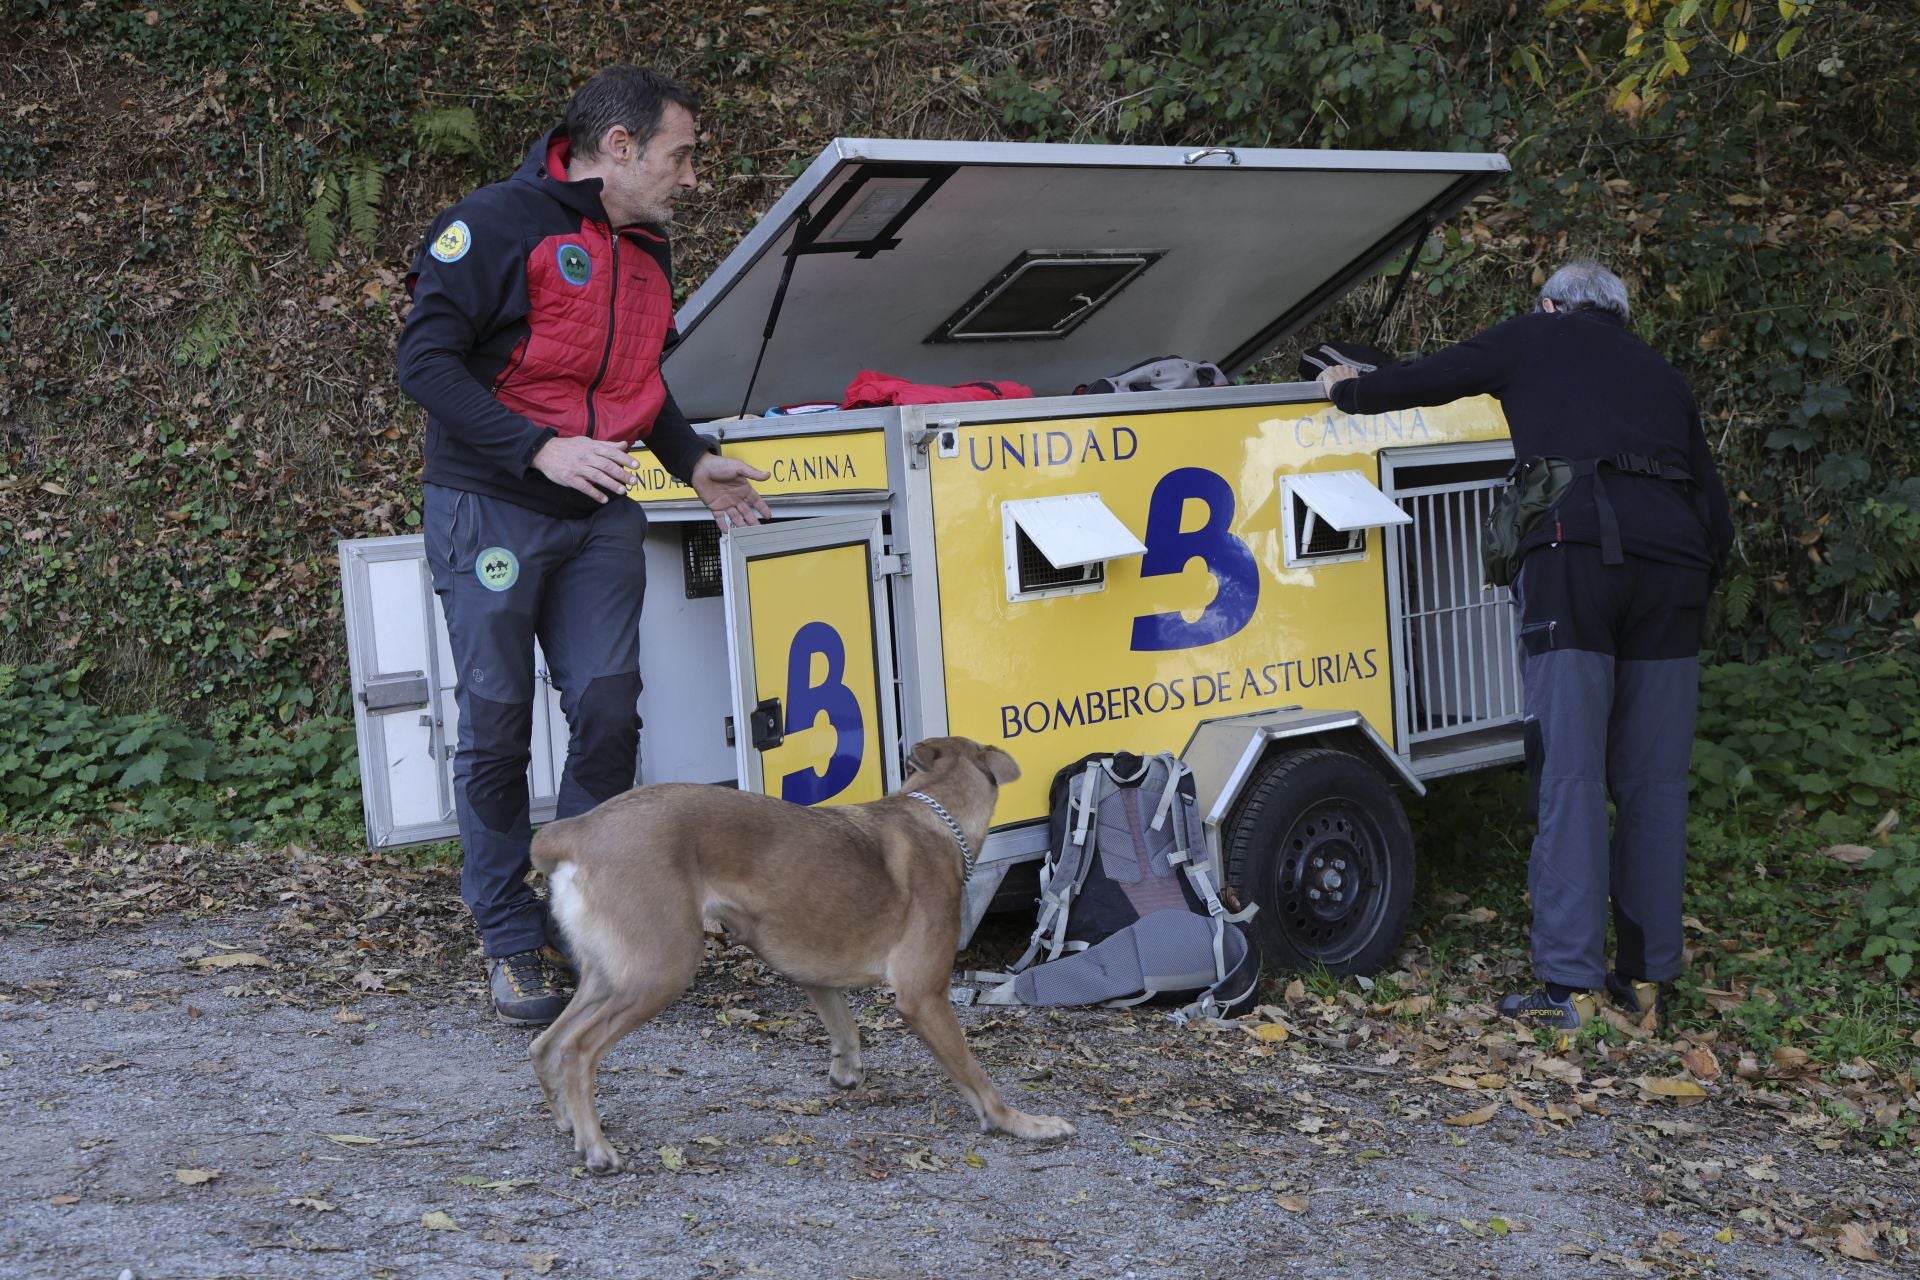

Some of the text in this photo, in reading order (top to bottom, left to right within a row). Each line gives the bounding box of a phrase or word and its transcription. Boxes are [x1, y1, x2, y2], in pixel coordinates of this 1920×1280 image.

[773, 453, 857, 483] CANINA
[968, 408, 1431, 472] UNIDAD CANINA
[1000, 648, 1378, 739] BOMBEROS DE ASTURIAS
